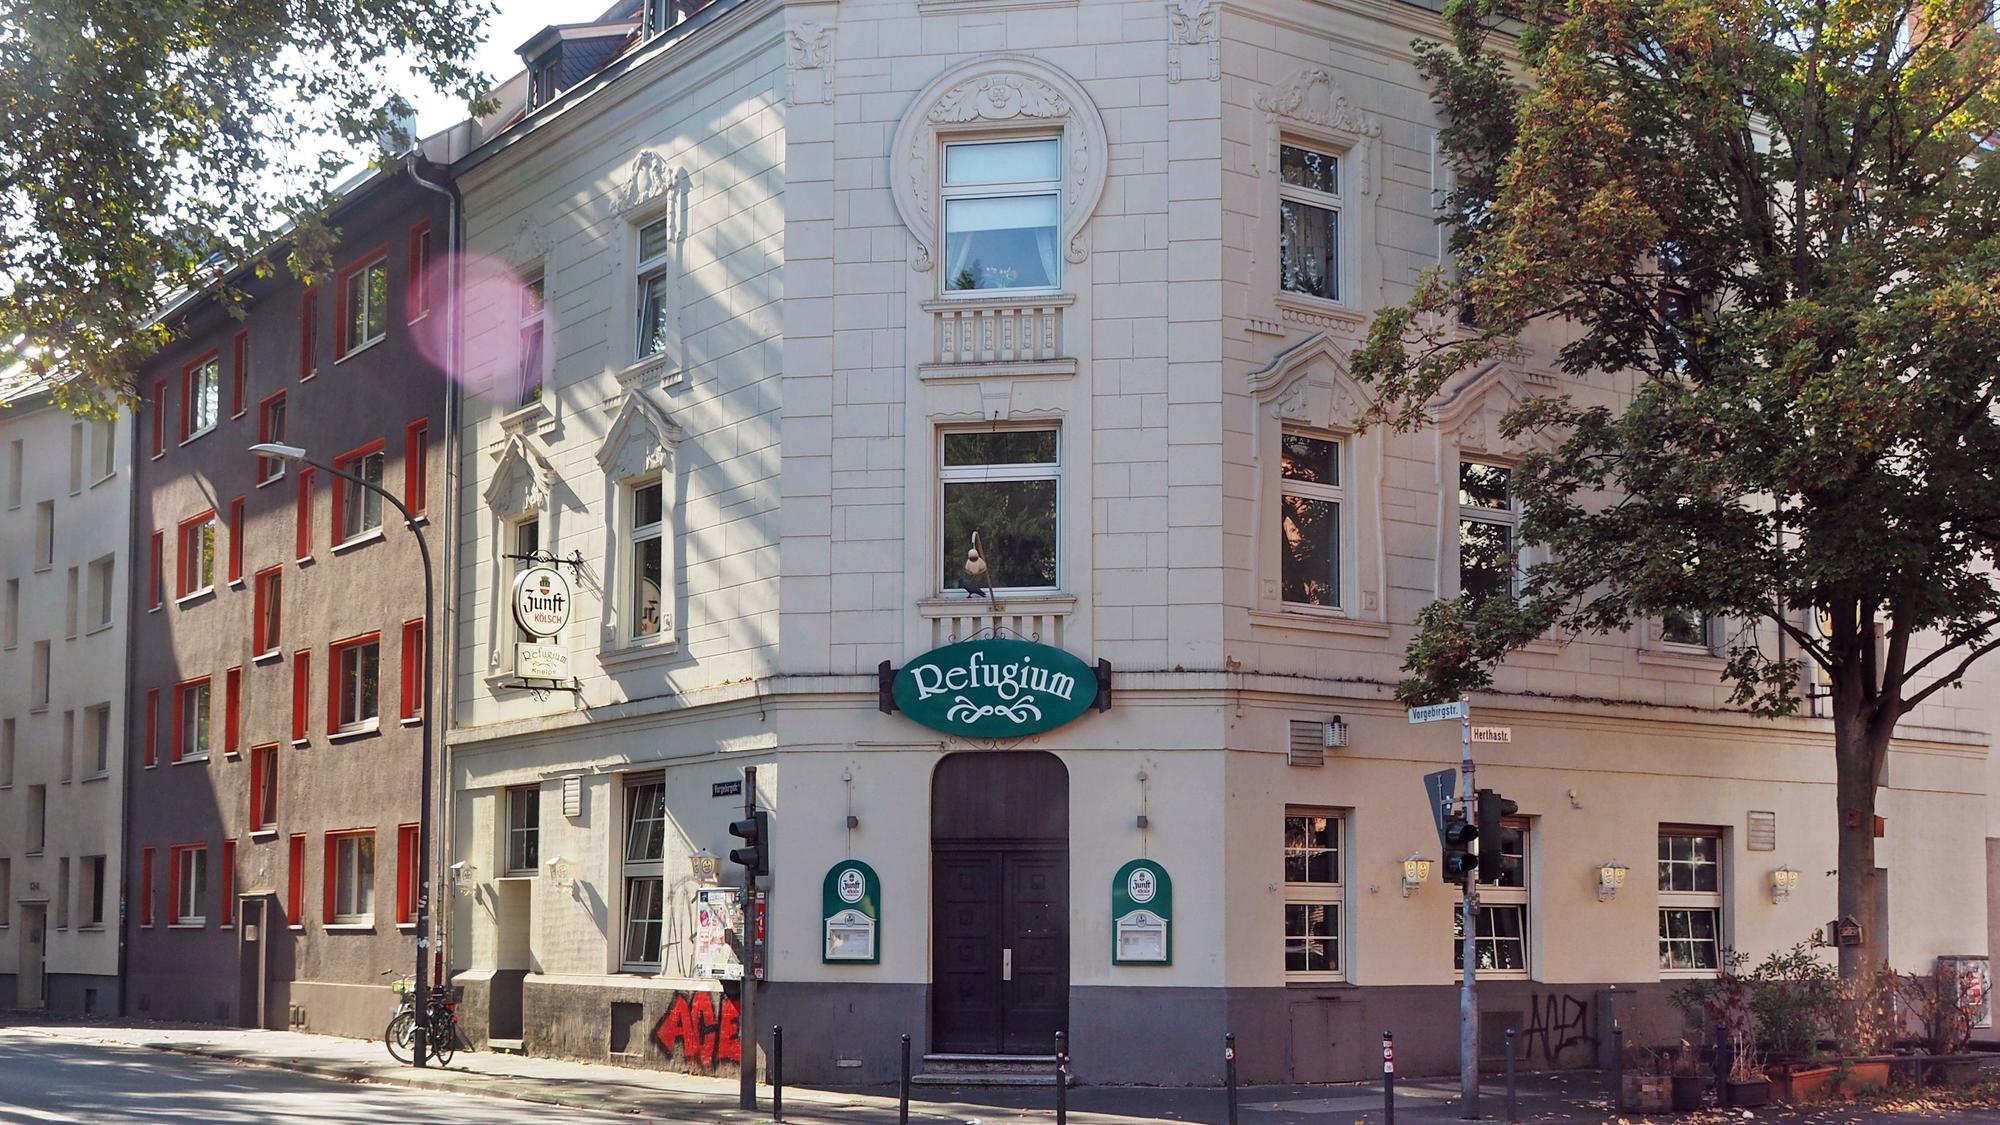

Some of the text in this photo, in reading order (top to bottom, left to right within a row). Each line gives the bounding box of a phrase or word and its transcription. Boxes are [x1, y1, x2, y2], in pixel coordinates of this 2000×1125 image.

[523, 589, 566, 613] Zunft
[534, 613, 562, 624] KÖLSCH
[522, 646, 567, 664] Refugium
[910, 651, 1075, 701] Refugium
[1412, 705, 1459, 721] Vorgebirgstr.
[1474, 728, 1509, 741] Herthastr.
